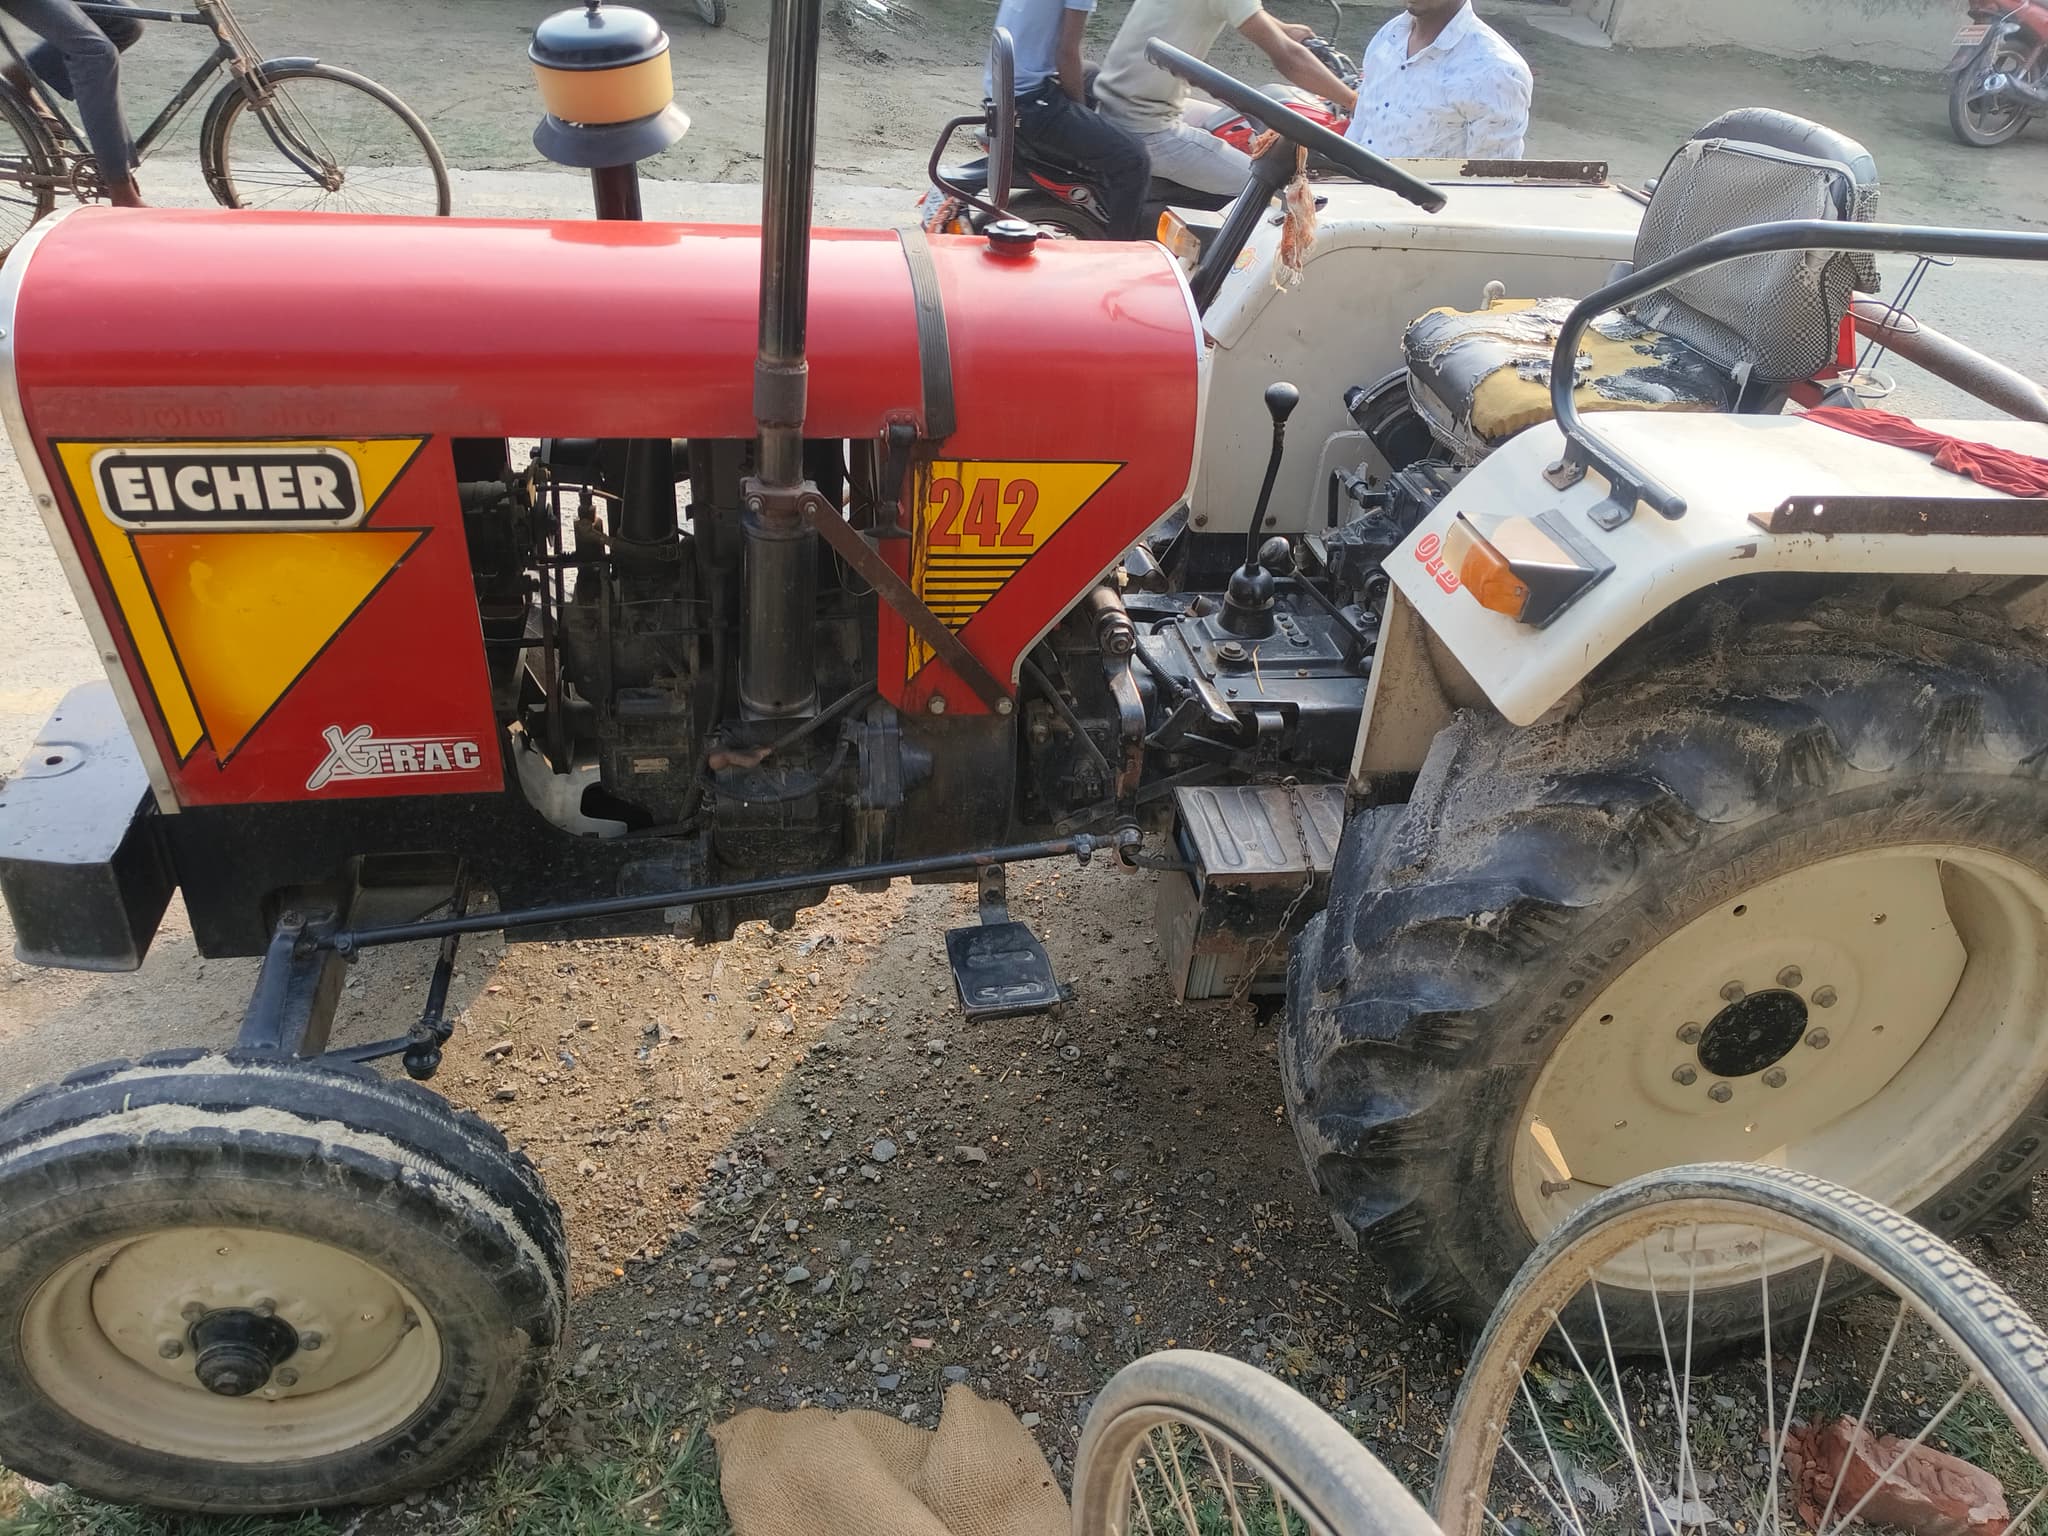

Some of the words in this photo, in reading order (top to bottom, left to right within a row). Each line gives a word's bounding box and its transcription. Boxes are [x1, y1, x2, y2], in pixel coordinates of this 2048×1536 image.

[110, 465, 346, 512] EICHER
[926, 477, 1040, 547] 242
[306, 725, 482, 791] XTRAC
[1937, 1136, 2040, 1222] apollo
